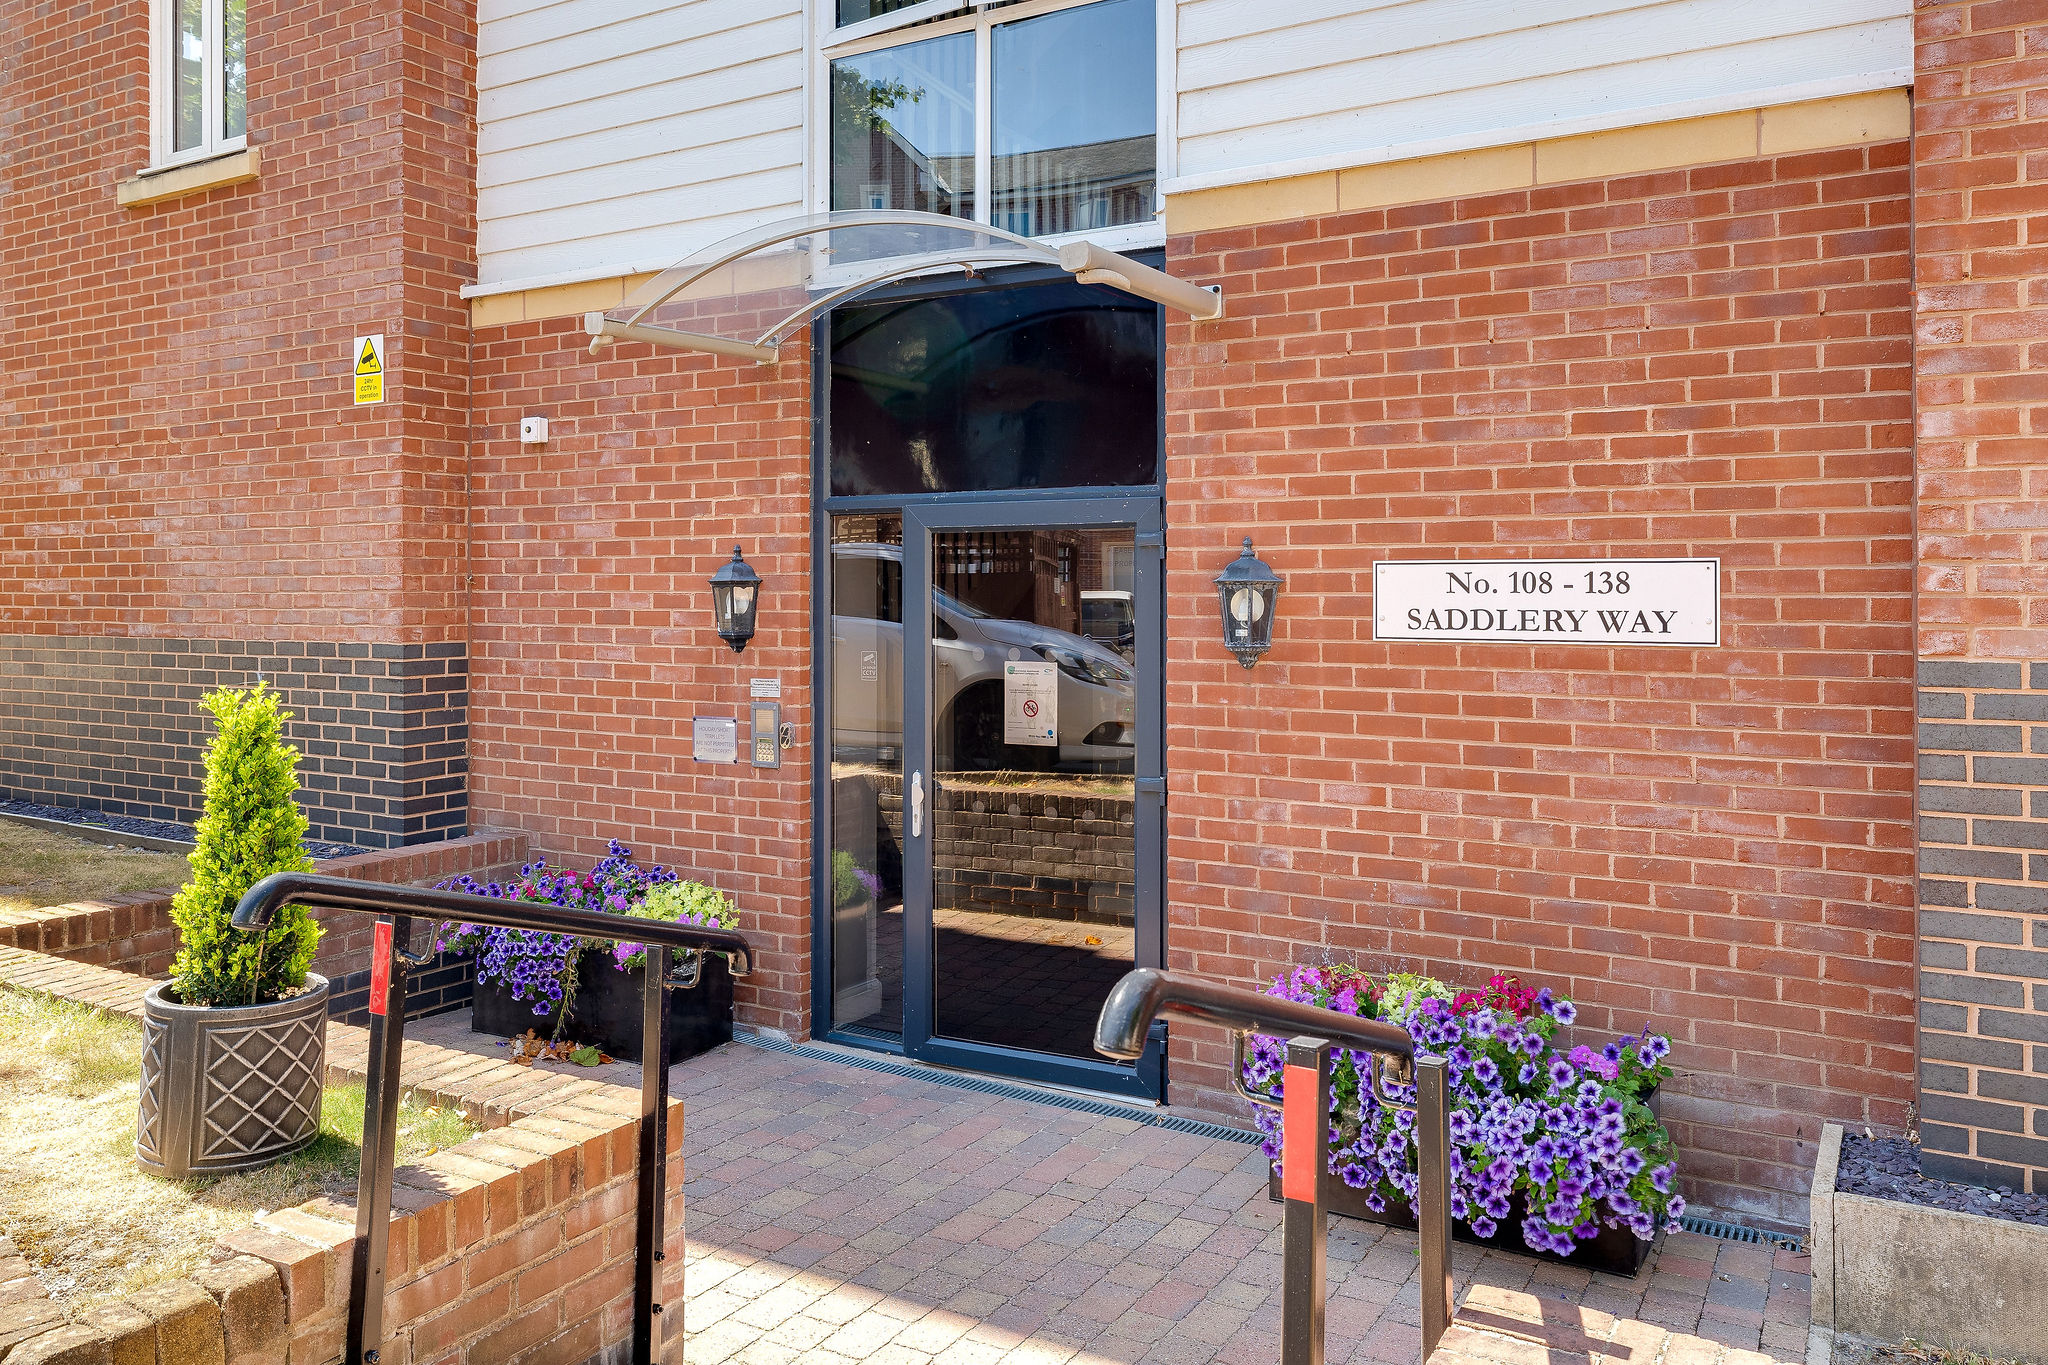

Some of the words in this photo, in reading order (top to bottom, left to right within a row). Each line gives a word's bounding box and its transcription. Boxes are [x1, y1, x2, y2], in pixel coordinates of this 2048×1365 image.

[359, 392, 379, 400] operation
[1446, 571, 1498, 594] No.
[1508, 571, 1553, 595] 108
[1584, 571, 1631, 595] 138
[1407, 608, 1589, 633] SADDLERY
[1597, 610, 1678, 634] WAY
